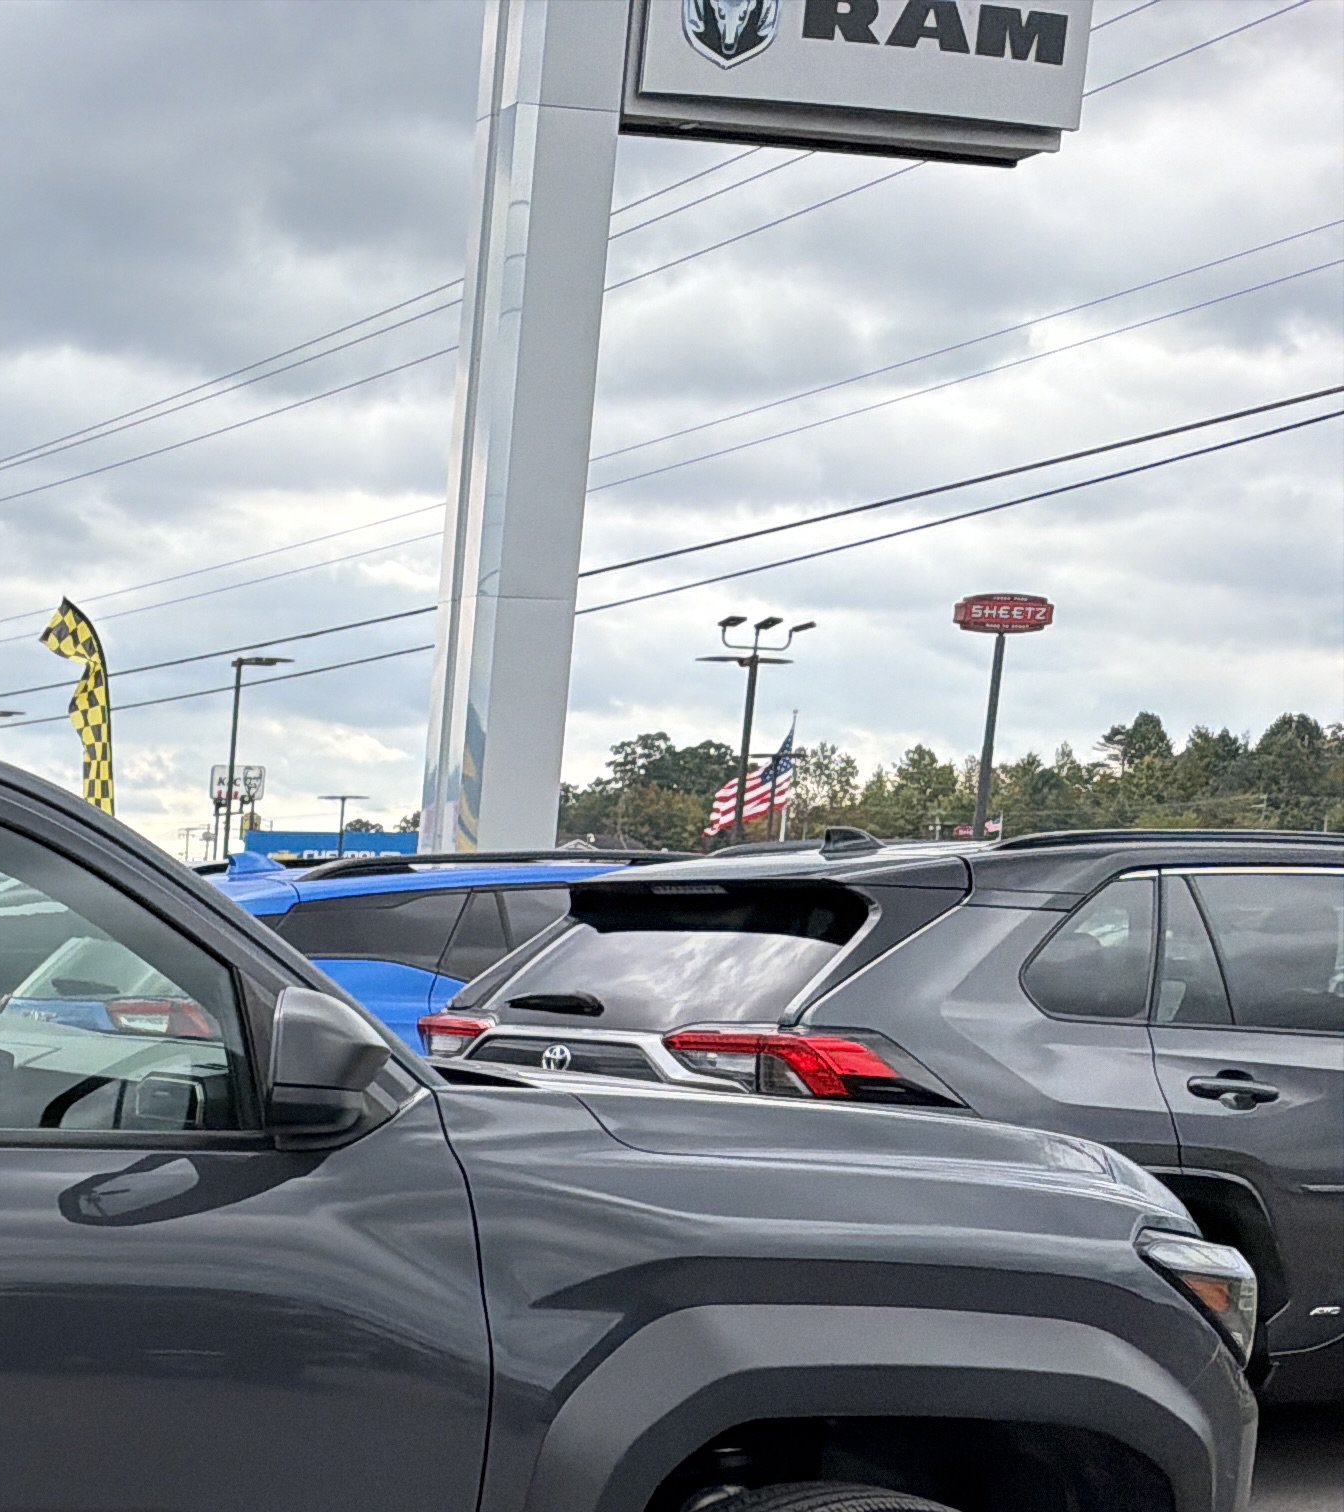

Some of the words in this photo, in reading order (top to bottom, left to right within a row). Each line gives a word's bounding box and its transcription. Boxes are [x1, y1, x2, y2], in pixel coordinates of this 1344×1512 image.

[802, 0, 1068, 65] RAM
[971, 605, 1047, 620] SHEETZ
[217, 776, 241, 788] KC
